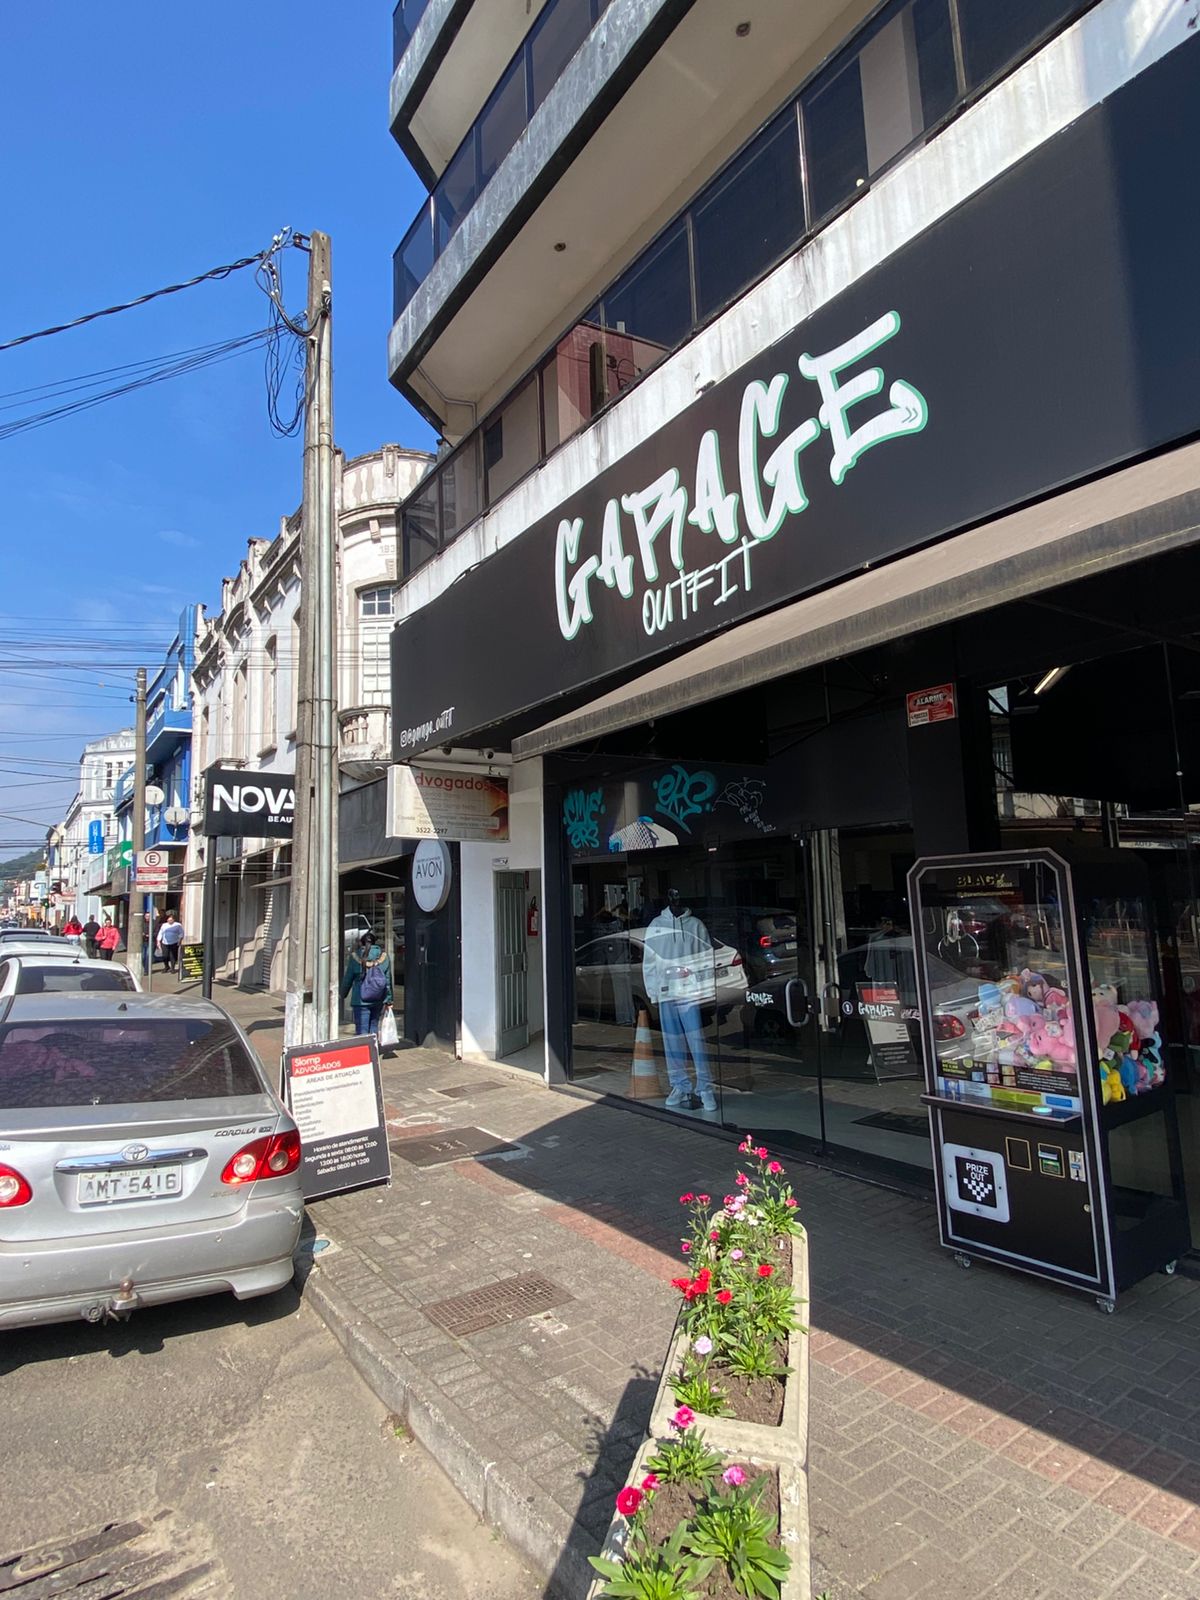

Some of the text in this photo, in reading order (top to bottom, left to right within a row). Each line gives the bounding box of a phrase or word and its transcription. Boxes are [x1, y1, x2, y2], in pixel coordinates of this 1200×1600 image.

[555, 310, 929, 640] GARAGE
[643, 537, 760, 636] OUTFIT
[916, 693, 944, 706] ALARME
[149, 855, 156, 863] E
[415, 860, 442, 879] AVON
[858, 1001, 895, 1017] GARAGE
[294, 1061, 341, 1075] ADVOGADOS
[215, 1128, 256, 1137] COROLLA
[966, 1162, 989, 1176] PRIZE
[971, 1172, 985, 1181] OUT
